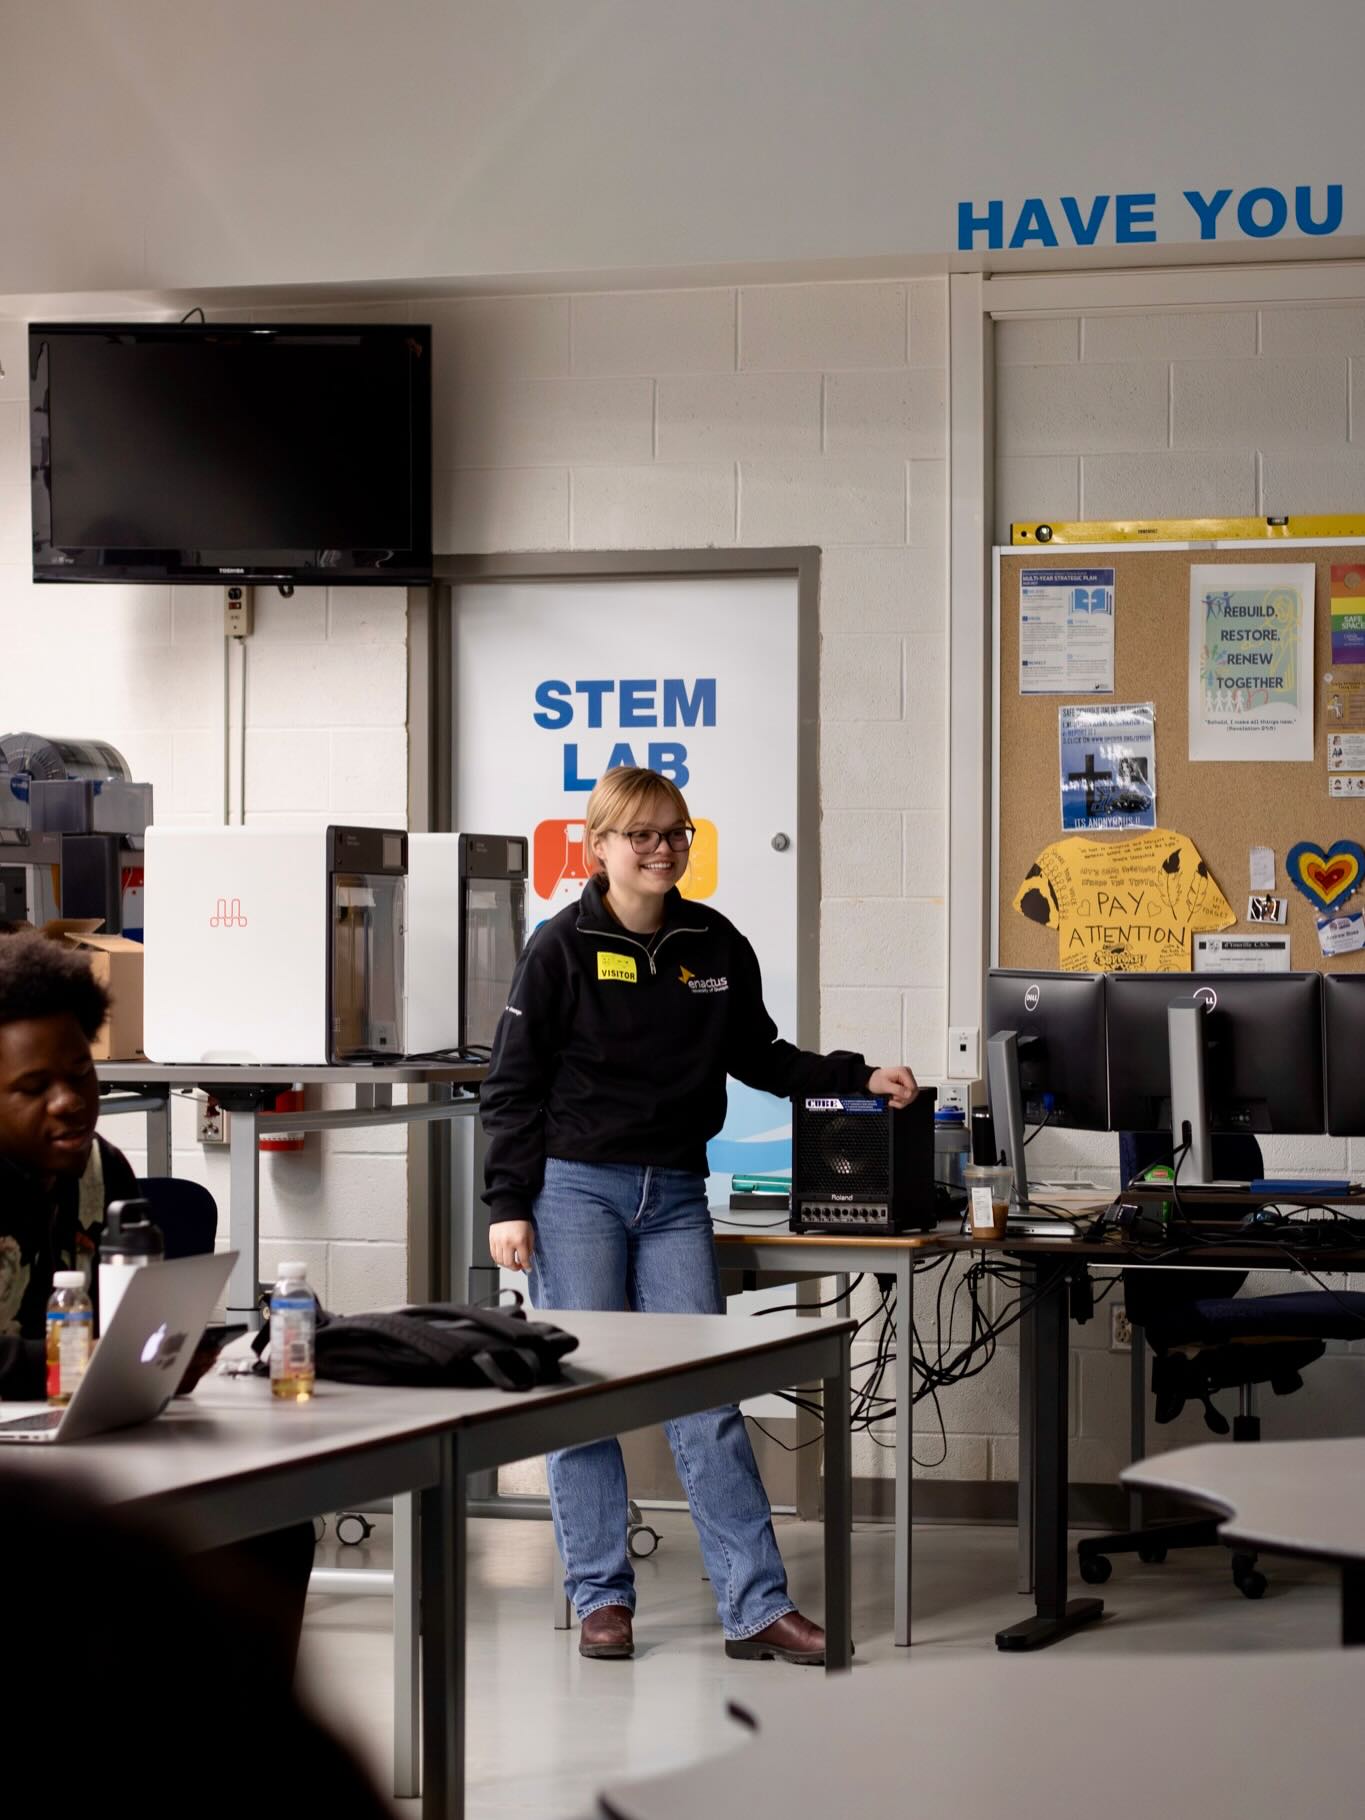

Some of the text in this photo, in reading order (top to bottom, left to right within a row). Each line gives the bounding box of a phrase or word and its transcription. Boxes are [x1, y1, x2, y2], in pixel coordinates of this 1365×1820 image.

[957, 184, 1343, 251] HAVE YOU
[1227, 653, 1273, 665] RENEW
[1216, 676, 1284, 689] TOGETHER
[533, 678, 716, 730] STEM
[1074, 818, 1087, 829] ITS
[1097, 890, 1145, 918] PAY
[1069, 924, 1186, 948] ATTENTION
[601, 969, 635, 981] VISITOR
[688, 976, 728, 989] enactus
[1026, 994, 1039, 1002] DELL
[807, 1099, 839, 1108] CUBE
